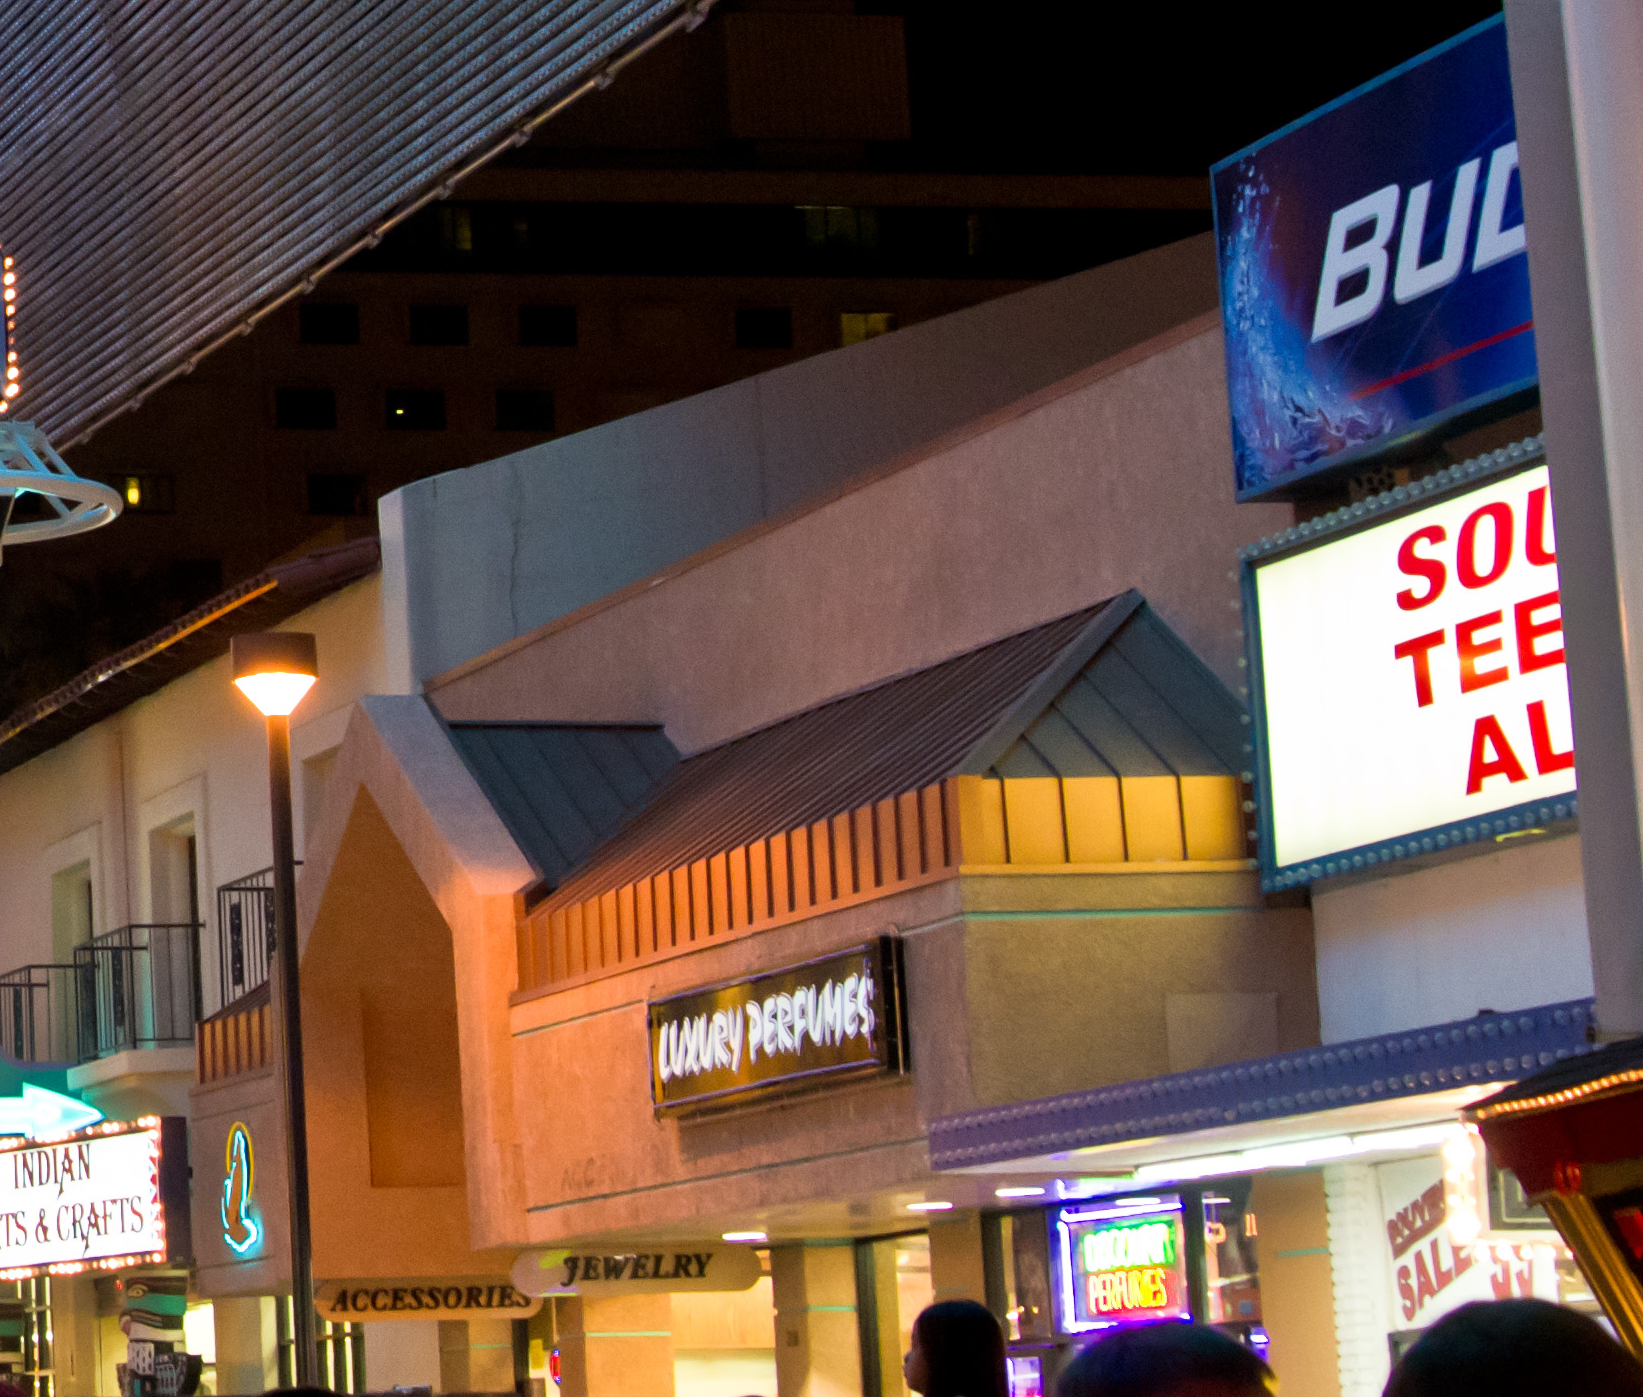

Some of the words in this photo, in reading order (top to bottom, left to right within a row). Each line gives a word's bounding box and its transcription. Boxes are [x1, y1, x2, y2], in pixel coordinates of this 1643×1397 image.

[658, 1004, 745, 1084] LUXURY
[745, 971, 876, 1065] PERFUMES
[12, 1143, 92, 1200] INDIAN
[34, 1209, 52, 1244] &
[56, 1196, 145, 1259] CRAFTS
[329, 1284, 533, 1313] ACCESSORIES
[560, 1253, 713, 1288] JEWELRY
[1087, 1267, 1169, 1315] PERFUMES
[1397, 1237, 1474, 1322] SALE
